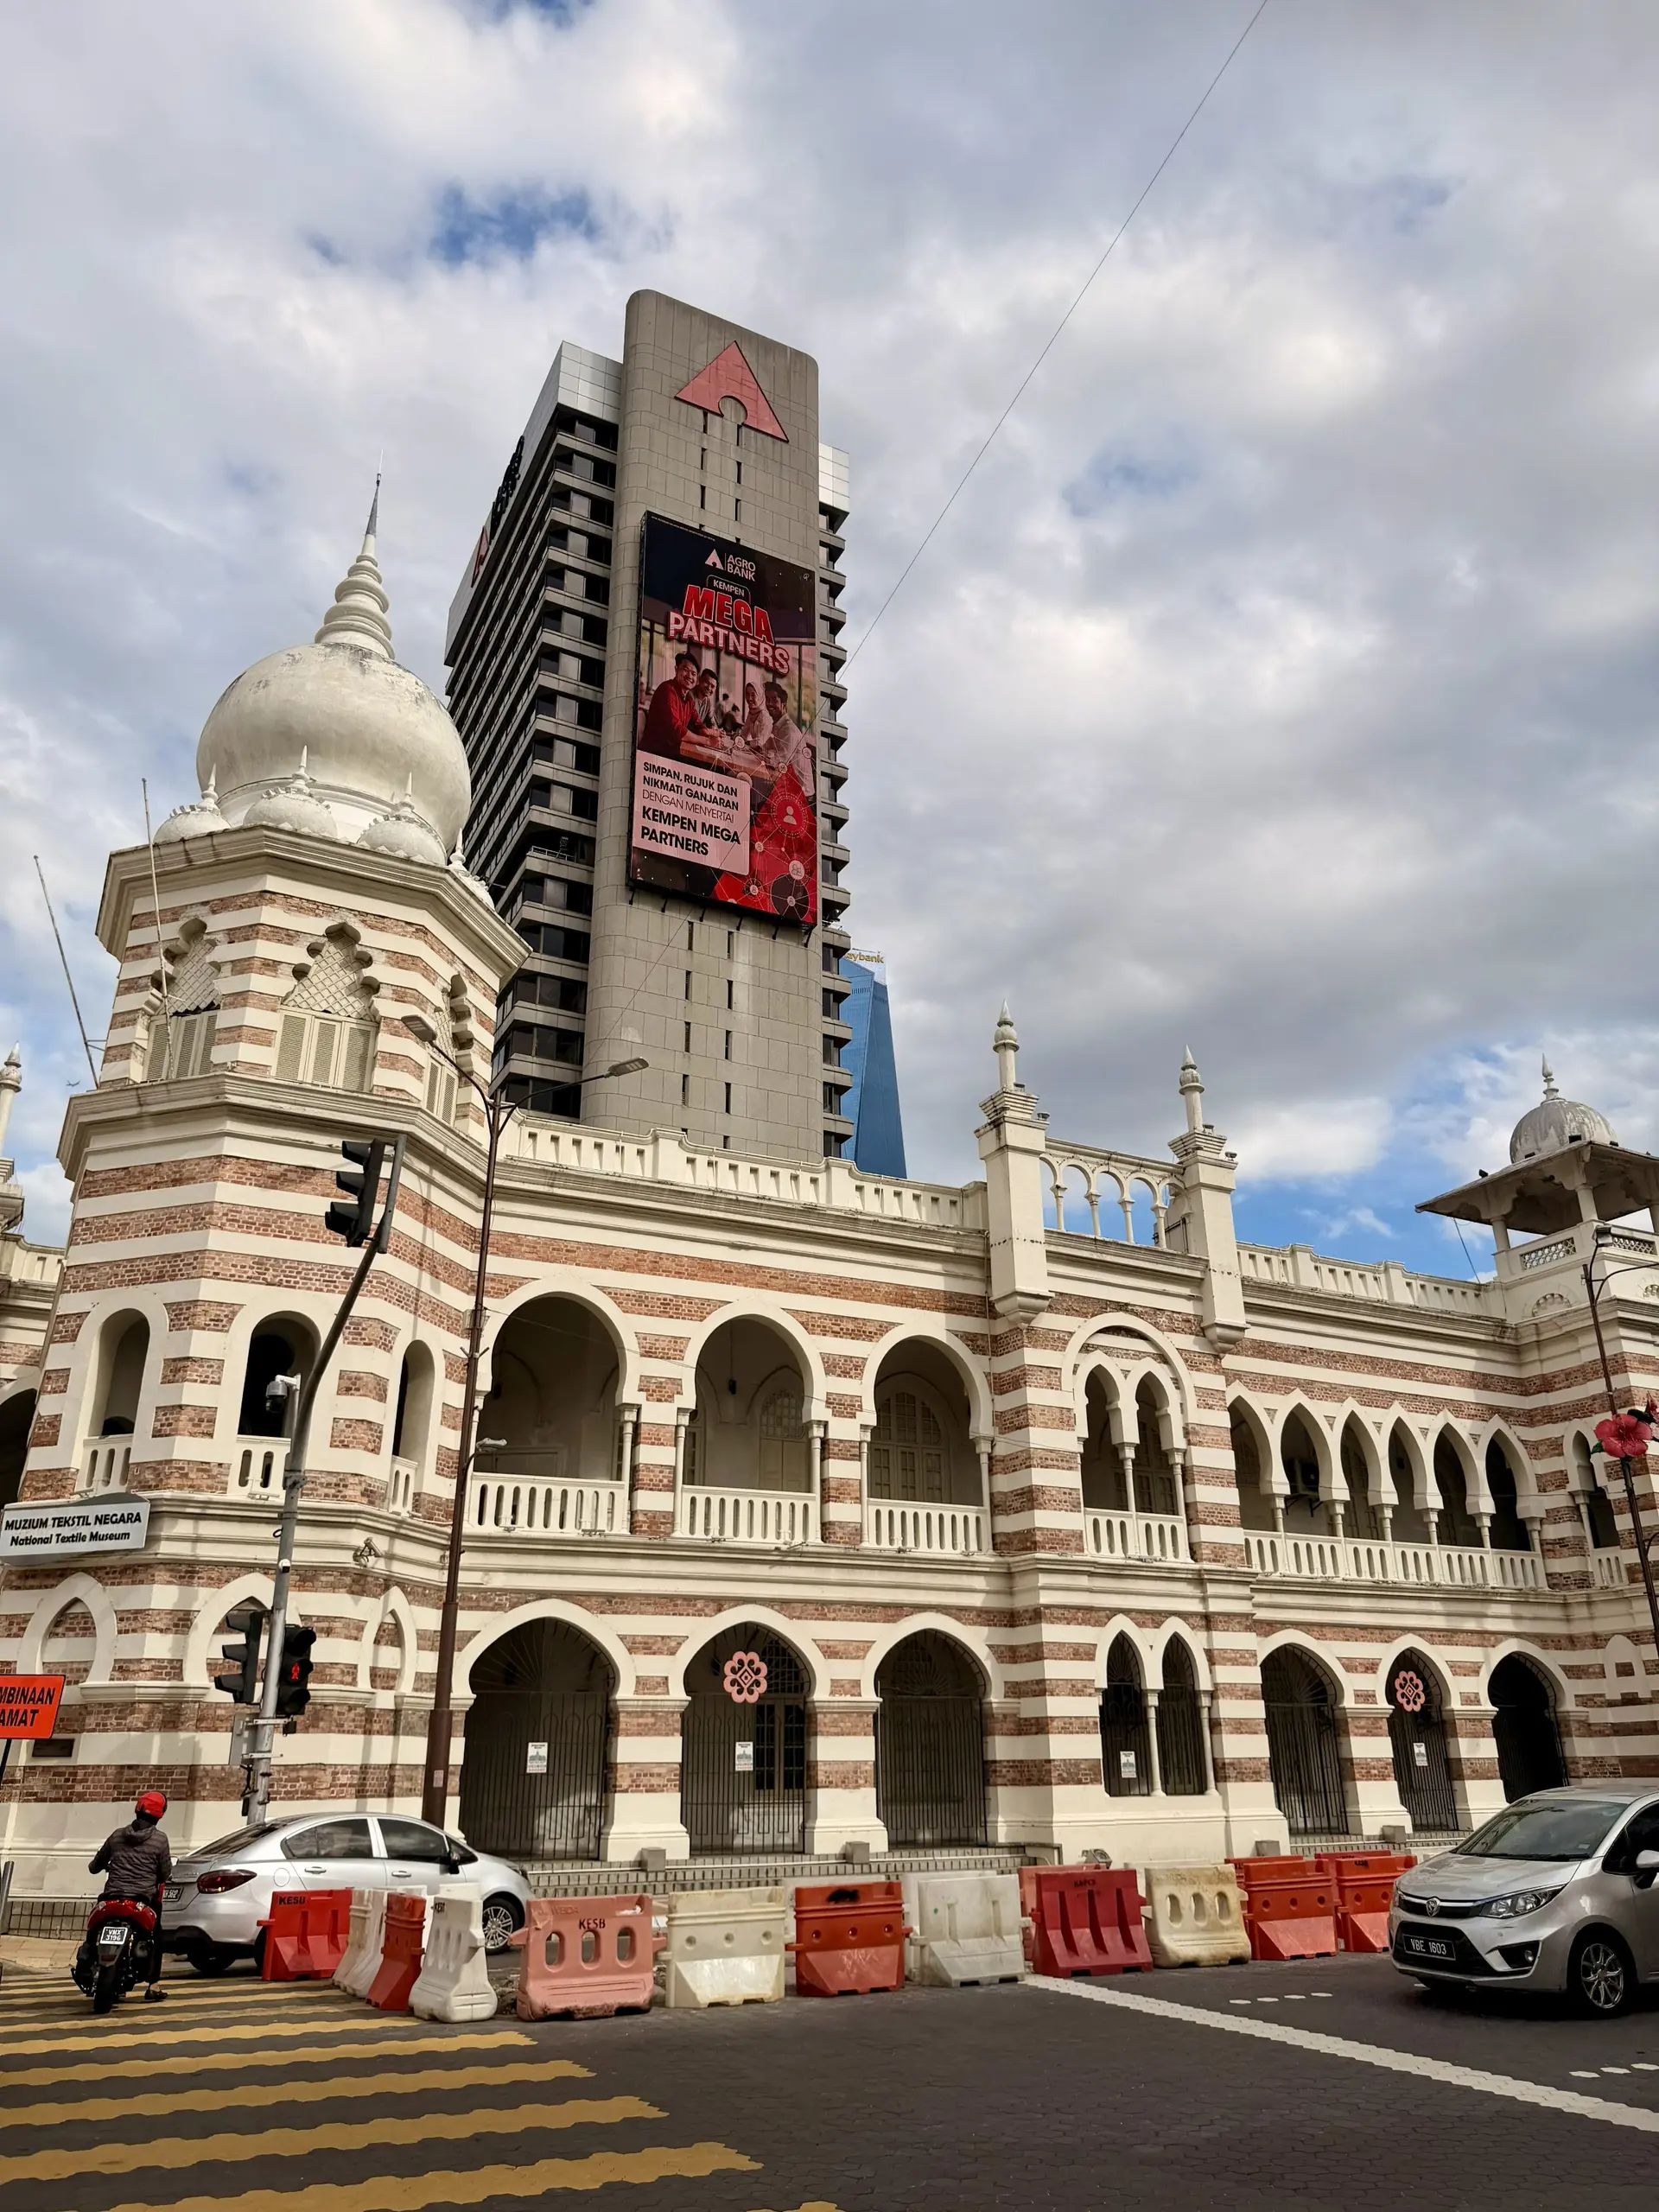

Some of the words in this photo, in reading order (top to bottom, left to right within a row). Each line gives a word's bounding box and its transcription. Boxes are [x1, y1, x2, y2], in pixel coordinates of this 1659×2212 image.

[727, 554, 756, 572] AGRO
[727, 563, 756, 582] BANK
[713, 579, 745, 597] KEMPEN
[682, 584, 775, 646] MEGA
[668, 610, 790, 675] PARTNERS
[643, 761, 683, 782] SIMPAN,
[683, 773, 715, 791] RUJUK
[716, 783, 738, 797] DAN
[643, 775, 683, 796] NIKMATI
[685, 788, 739, 811] GANJARAN
[642, 789, 683, 810] DENGAN
[685, 801, 734, 823] MENYERTAI
[642, 805, 697, 833] KEMPEN
[701, 822, 741, 845] MEGA
[640, 825, 709, 856] PARTNERS
[4, 1515, 48, 1531] MUZIUM
[51, 1513, 92, 1529] TEKSTIL
[93, 1512, 142, 1526] NEGARA
[10, 1533, 53, 1547] National
[55, 1532, 87, 1545] Textile
[89, 1530, 130, 1542] Museum
[578, 1917, 606, 1929] KESB
[1410, 1938, 1426, 1952] VBE
[1428, 1942, 1447, 1955] 1603
